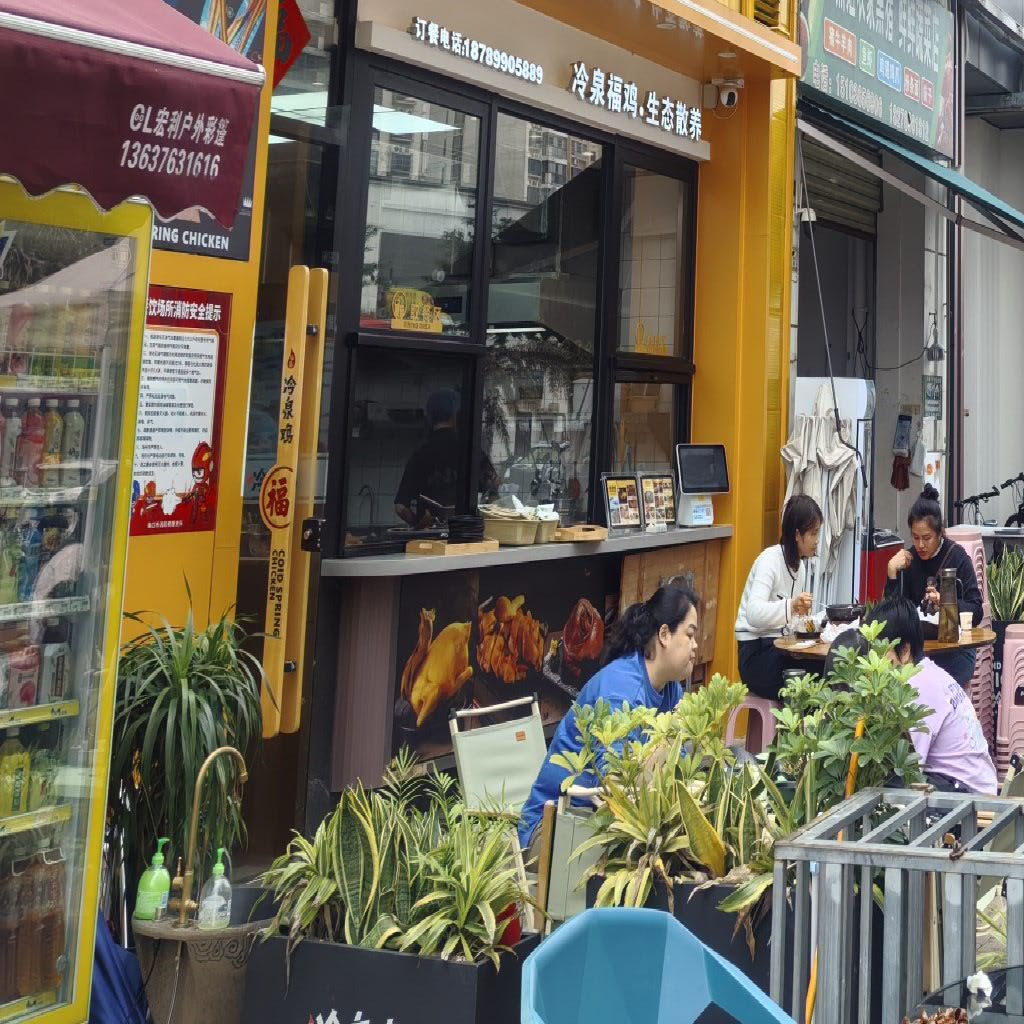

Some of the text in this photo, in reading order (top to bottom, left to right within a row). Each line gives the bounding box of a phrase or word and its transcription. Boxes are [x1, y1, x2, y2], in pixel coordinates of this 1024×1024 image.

[120, 139, 221, 180] 13637631616
[182, 230, 229, 251] CHICKEN
[147, 297, 222, 321] 饮场所消防安全提示
[280, 375, 297, 444] 冷泉鸡
[266, 476, 290, 518] 福
[268, 549, 278, 601] CHICKEN
[272, 587, 283, 639] SPRING
